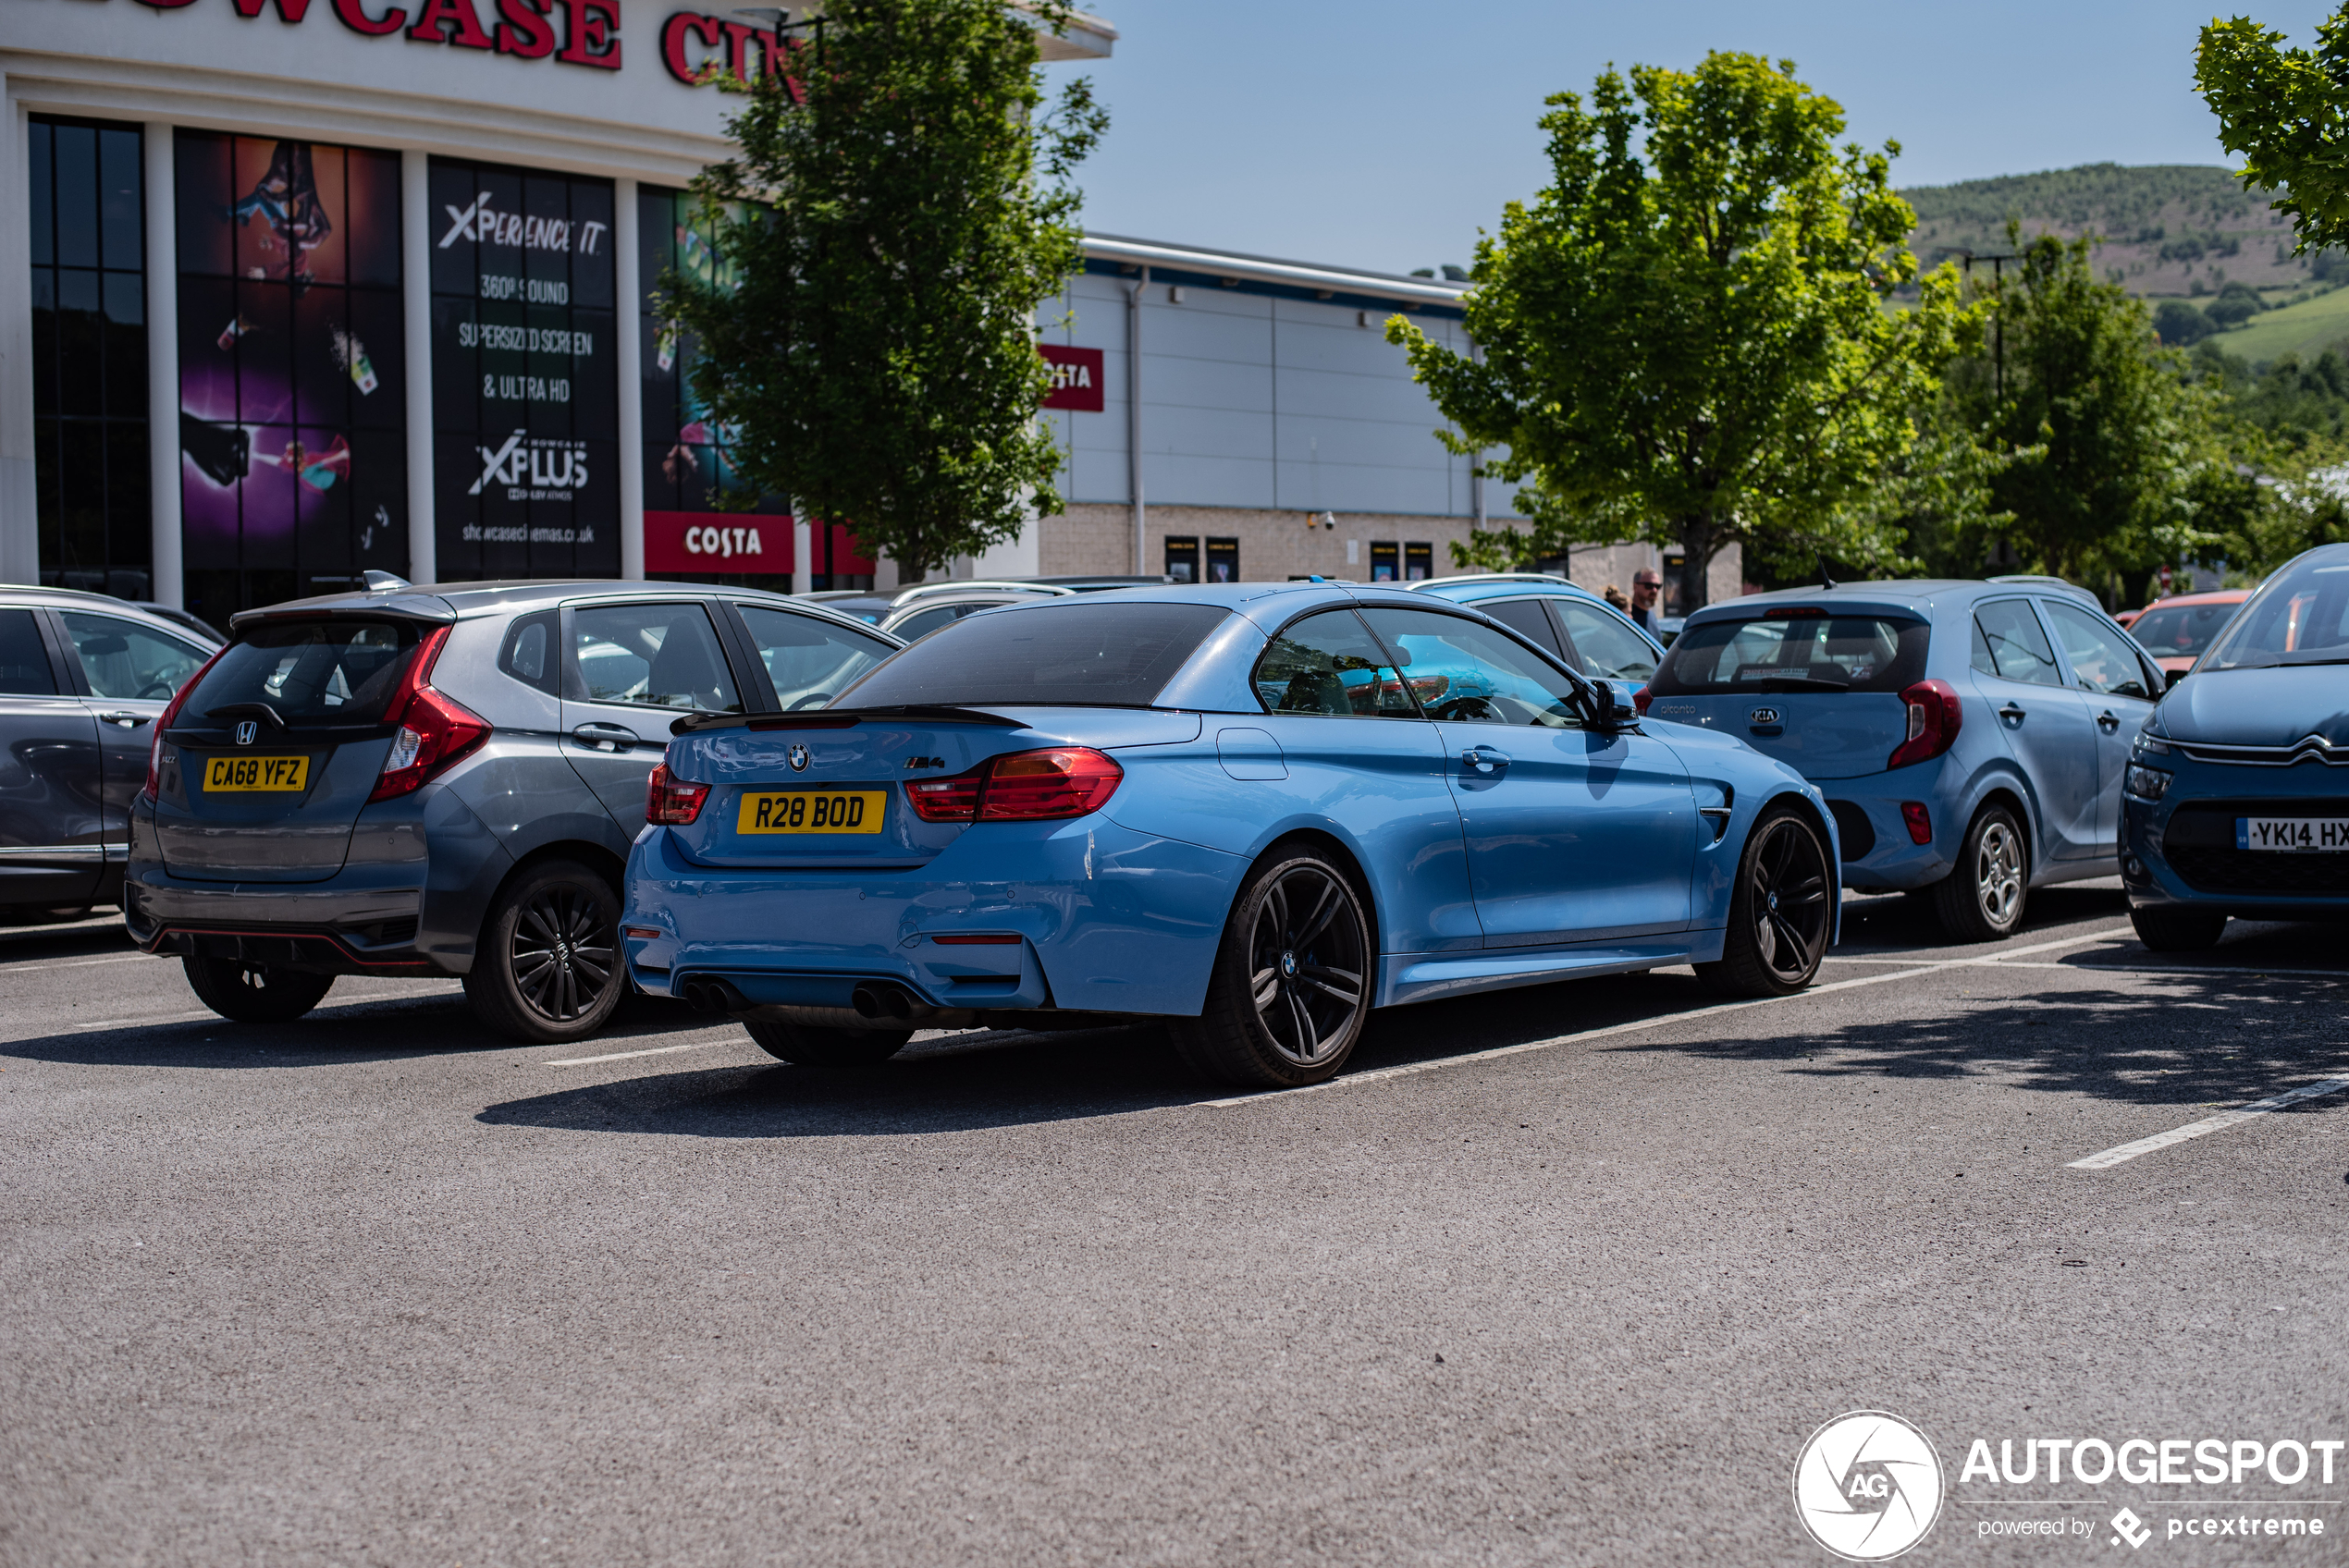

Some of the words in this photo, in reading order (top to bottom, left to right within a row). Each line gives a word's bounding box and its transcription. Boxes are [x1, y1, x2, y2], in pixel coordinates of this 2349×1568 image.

[438, 190, 575, 252] XPERIENCE
[580, 220, 608, 256] IT
[519, 277, 570, 306] SOUND
[459, 322, 540, 352] SUPERSIZED
[541, 328, 593, 356] SCREEN
[483, 374, 496, 398] &
[499, 375, 547, 401] ULTRA
[549, 378, 571, 402] HD
[1041, 361, 1091, 390] OSTA
[685, 525, 763, 558] COSTA
[1660, 704, 1696, 717] picanto
[1753, 708, 1776, 721] KIA
[212, 759, 259, 786] CA68
[264, 759, 301, 785] YFZ
[755, 797, 806, 828] R28
[810, 796, 865, 827] BOD
[2257, 822, 2313, 846] YK14
